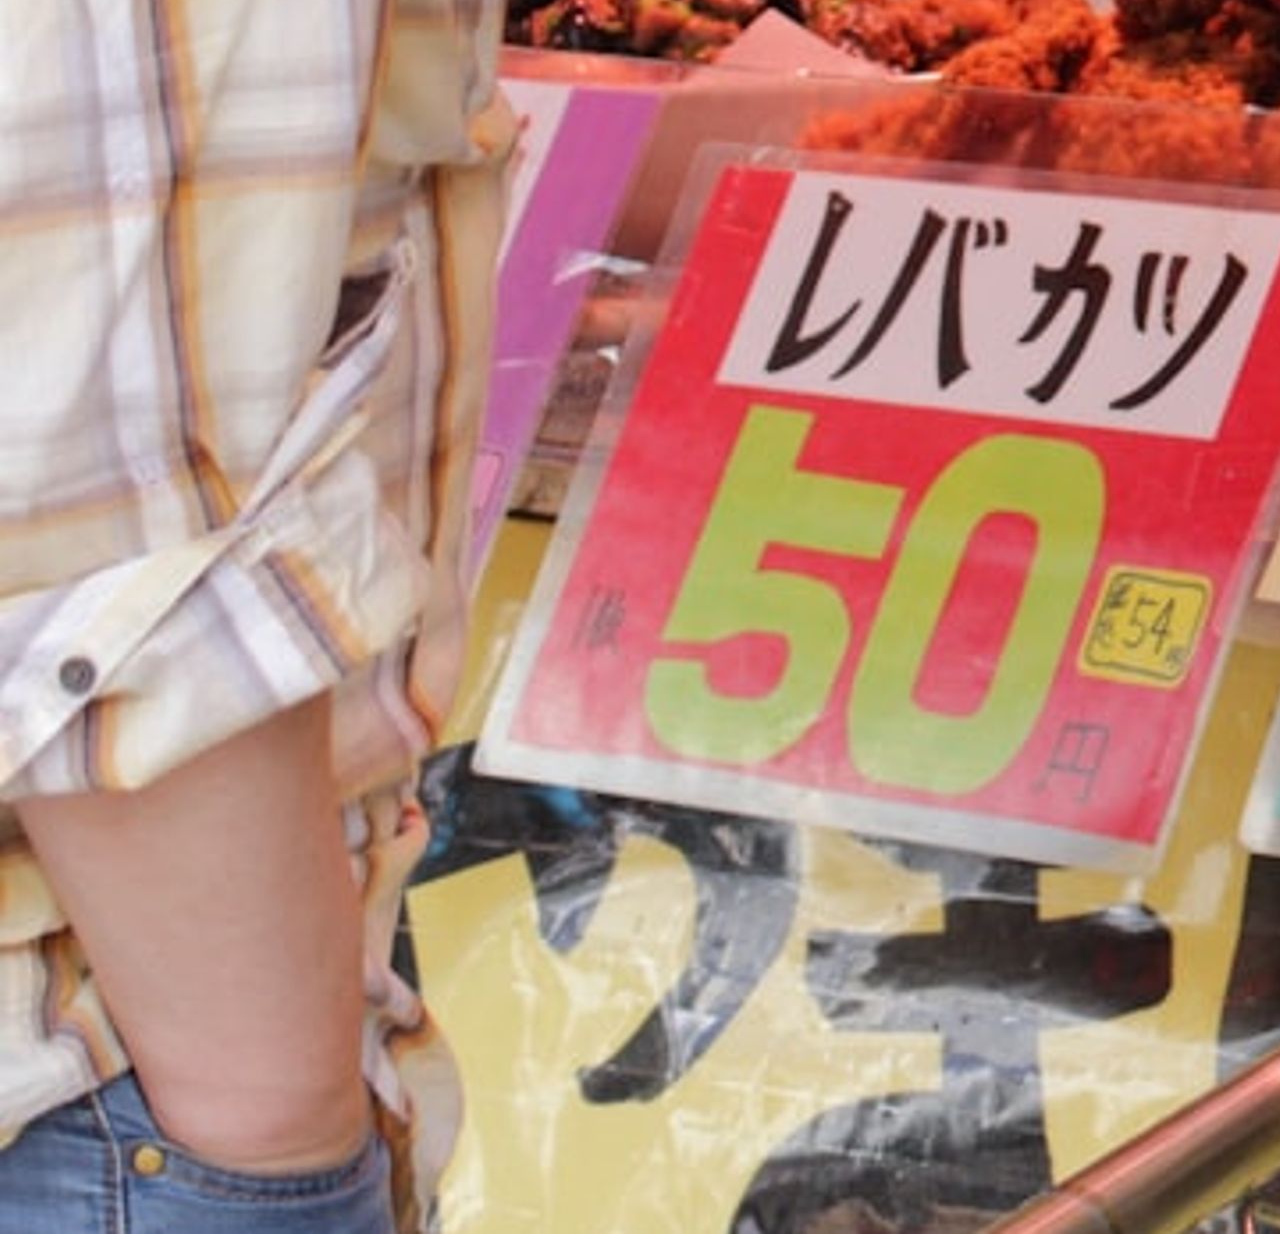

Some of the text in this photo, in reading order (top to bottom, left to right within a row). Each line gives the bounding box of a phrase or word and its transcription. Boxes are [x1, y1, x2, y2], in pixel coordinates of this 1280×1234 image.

[764, 189, 1250, 412] レバカツ
[642, 402, 1108, 797] 50
[1034, 721, 1113, 804] 円
